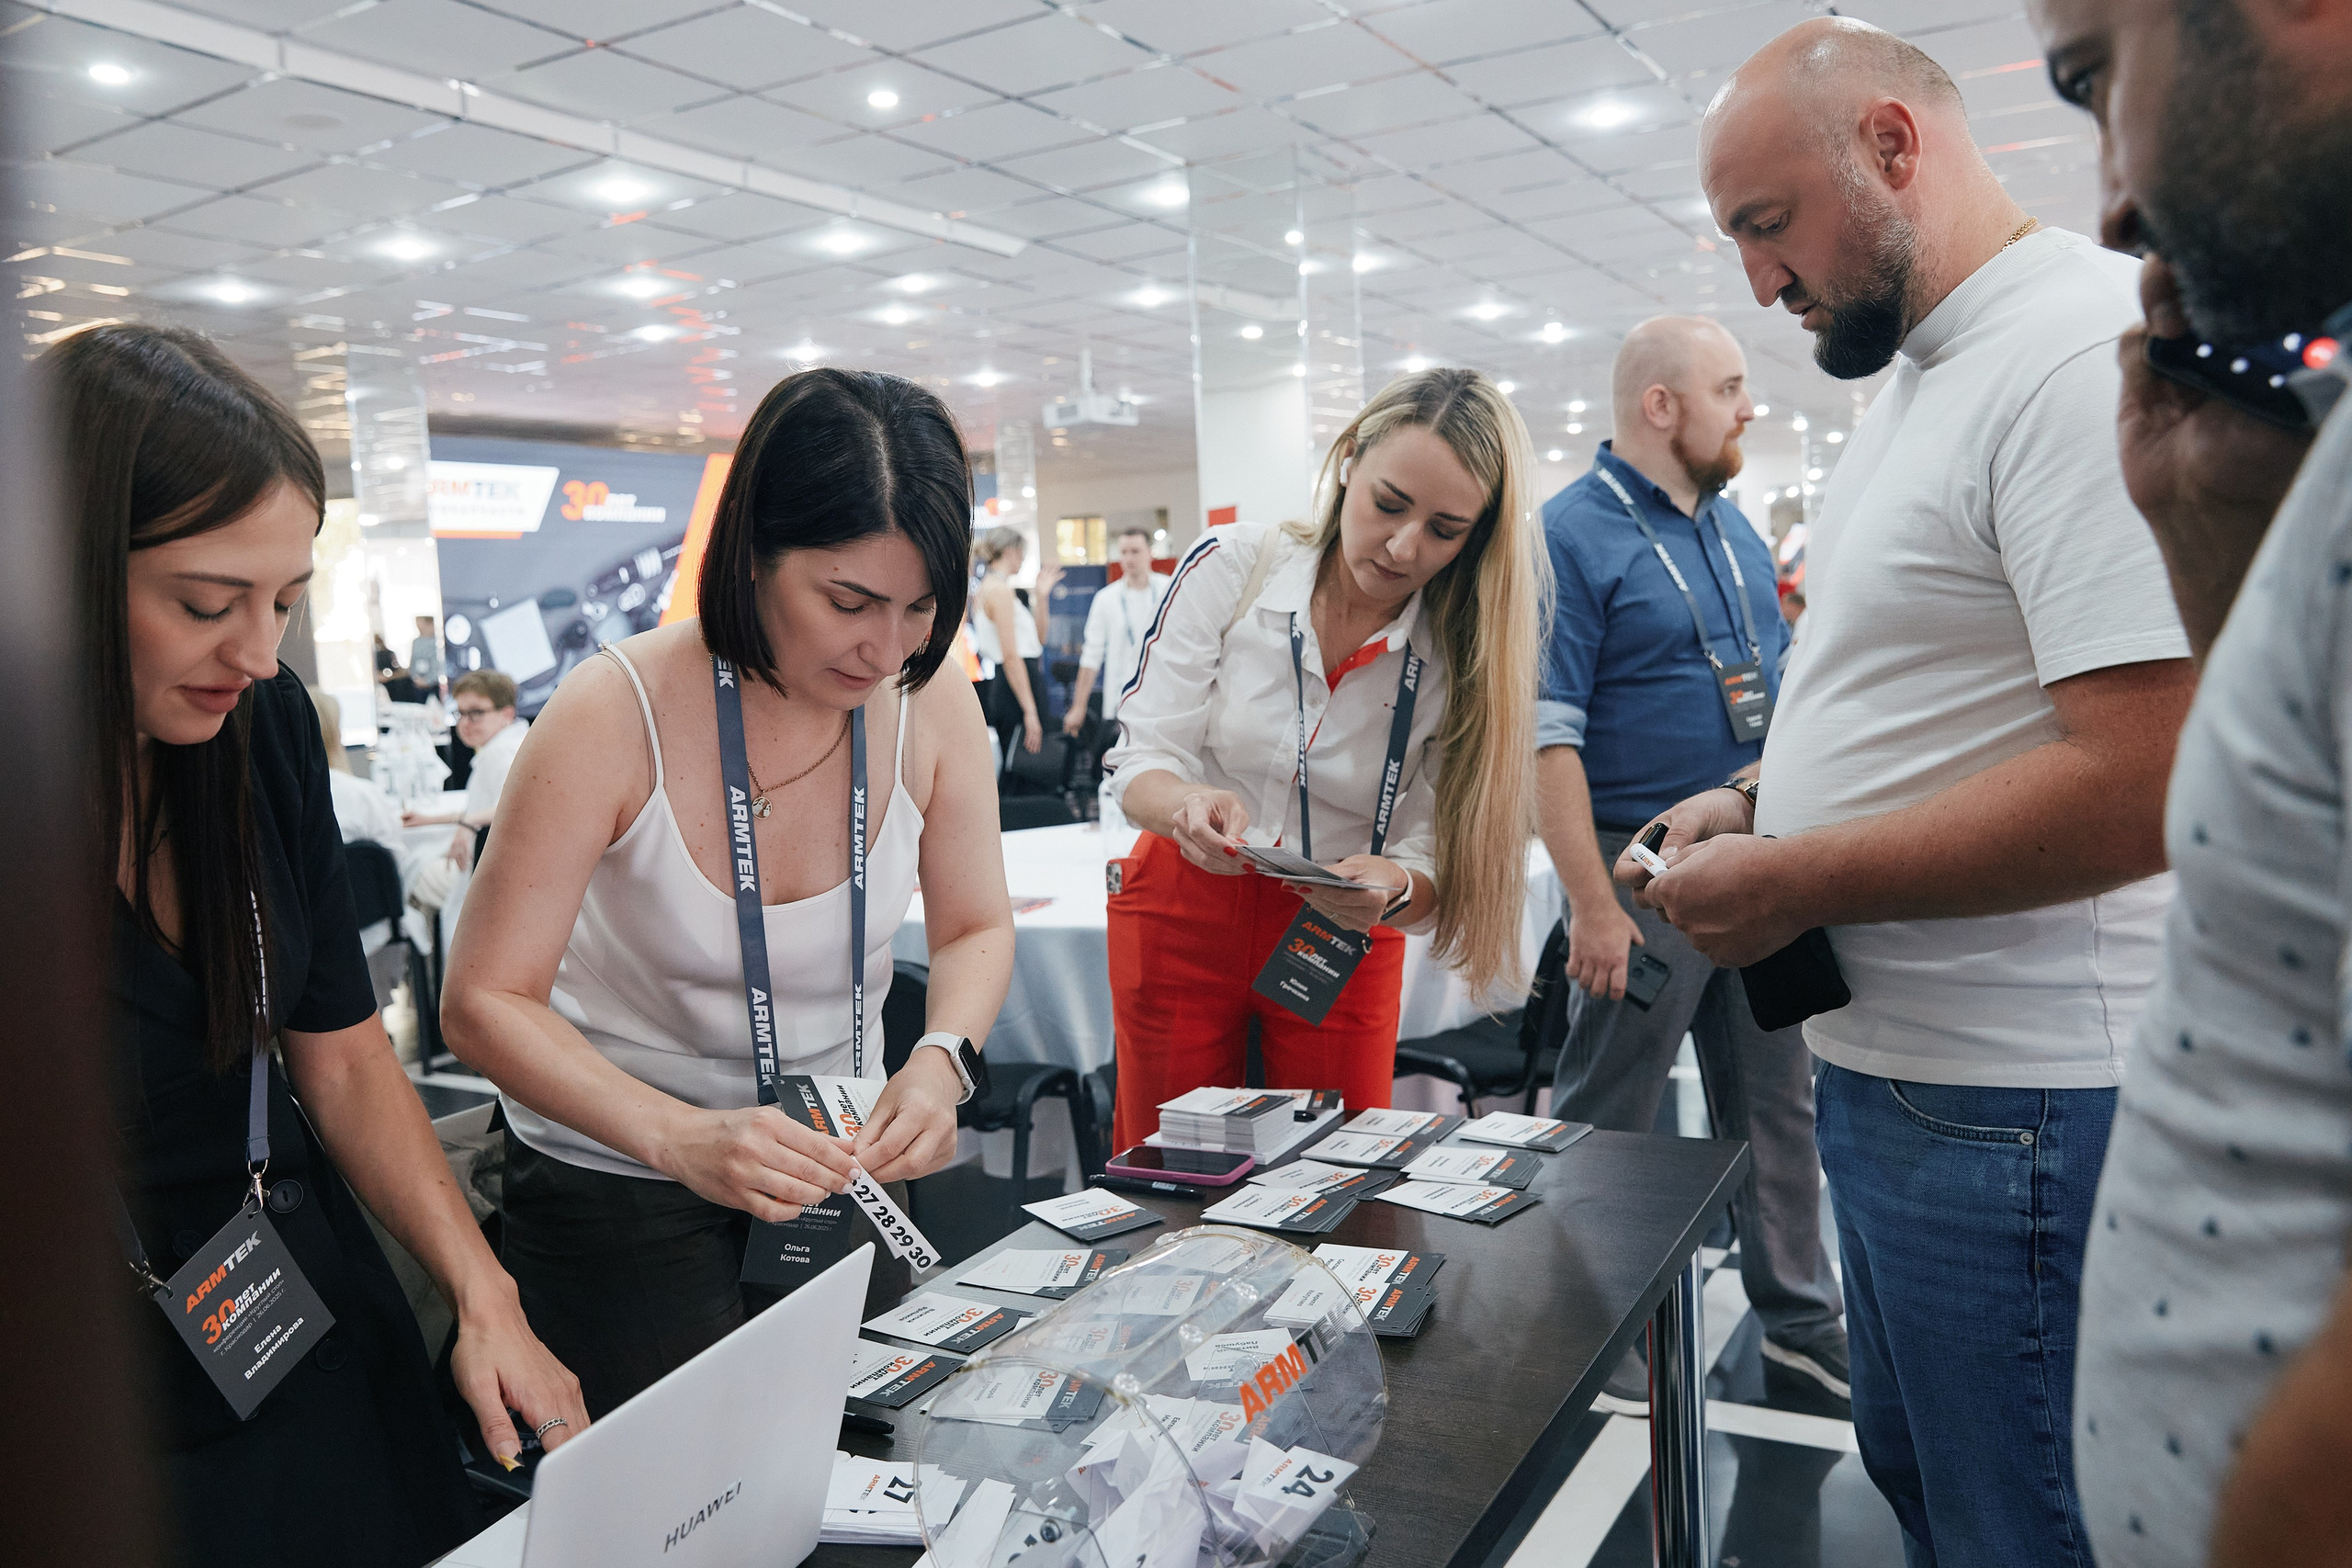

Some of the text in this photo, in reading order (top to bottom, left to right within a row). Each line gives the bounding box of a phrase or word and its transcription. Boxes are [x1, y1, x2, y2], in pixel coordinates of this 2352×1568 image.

[1376, 758, 1400, 836] ARMTEK
[729, 785, 755, 892] ARMTEK
[854, 785, 865, 891] ARMTEK
[1288, 938, 1316, 957] 30
[1301, 921, 1358, 957] ARMTEK
[854, 983, 863, 1078] ARMTEK
[837, 1084, 864, 1126] компании
[838, 1100, 851, 1115] лет
[1076, 1213, 1136, 1231] ARMTEK
[1289, 1199, 1329, 1223] ARMTEK
[854, 1184, 879, 1204] 27
[872, 1205, 896, 1228] 28
[889, 1225, 913, 1247] 29
[909, 1247, 931, 1269] 30
[780, 1253, 810, 1264] Котова
[784, 1243, 810, 1253] Ольга
[1064, 1254, 1081, 1267] 30
[1378, 1254, 1396, 1268] 30
[187, 1230, 262, 1314] ARMTEK
[1084, 1253, 1106, 1281] ARMTEK
[1393, 1256, 1420, 1285] ARMTEK
[221, 1268, 282, 1331] компании
[234, 1282, 255, 1308] лет
[256, 1292, 282, 1319] 26.06.2025
[1358, 1287, 1377, 1302] 30
[1374, 1288, 1404, 1321] ARMTEK
[202, 1298, 236, 1345] 30
[951, 1313, 1005, 1345] ARMTEK
[958, 1307, 983, 1323] 30
[213, 1316, 248, 1353] конференция
[243, 1316, 305, 1380] Владимирова
[254, 1324, 282, 1354] Елена
[873, 1369, 888, 1382] лет
[887, 1356, 914, 1372] 30
[879, 1360, 936, 1398] ARMTEK
[1038, 1371, 1059, 1387] 30
[1191, 1419, 1220, 1452] компании
[1209, 1429, 1223, 1442] лет
[1219, 1411, 1241, 1431] 30
[859, 1474, 881, 1501] ARMTEK
[1259, 1458, 1294, 1488] ARMTEK
[1281, 1463, 1335, 1498] 24
[664, 1481, 741, 1552] HUAWEI
